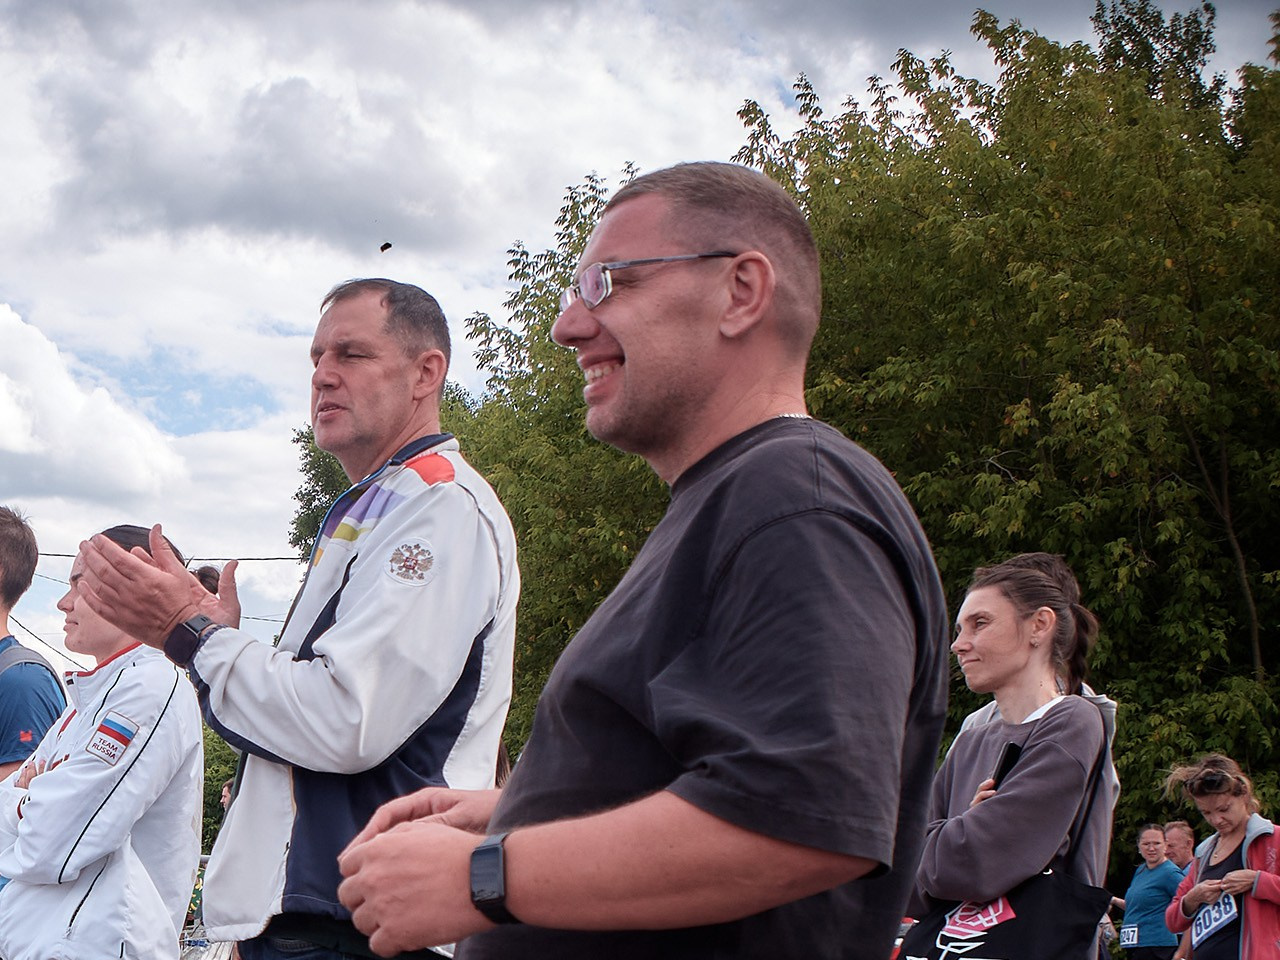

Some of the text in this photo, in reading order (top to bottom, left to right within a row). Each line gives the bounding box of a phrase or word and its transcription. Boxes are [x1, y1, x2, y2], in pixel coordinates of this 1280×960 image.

[91, 743, 117, 760] RUSSIA
[99, 738, 119, 752] TEAM
[1195, 895, 1233, 938] 6038
